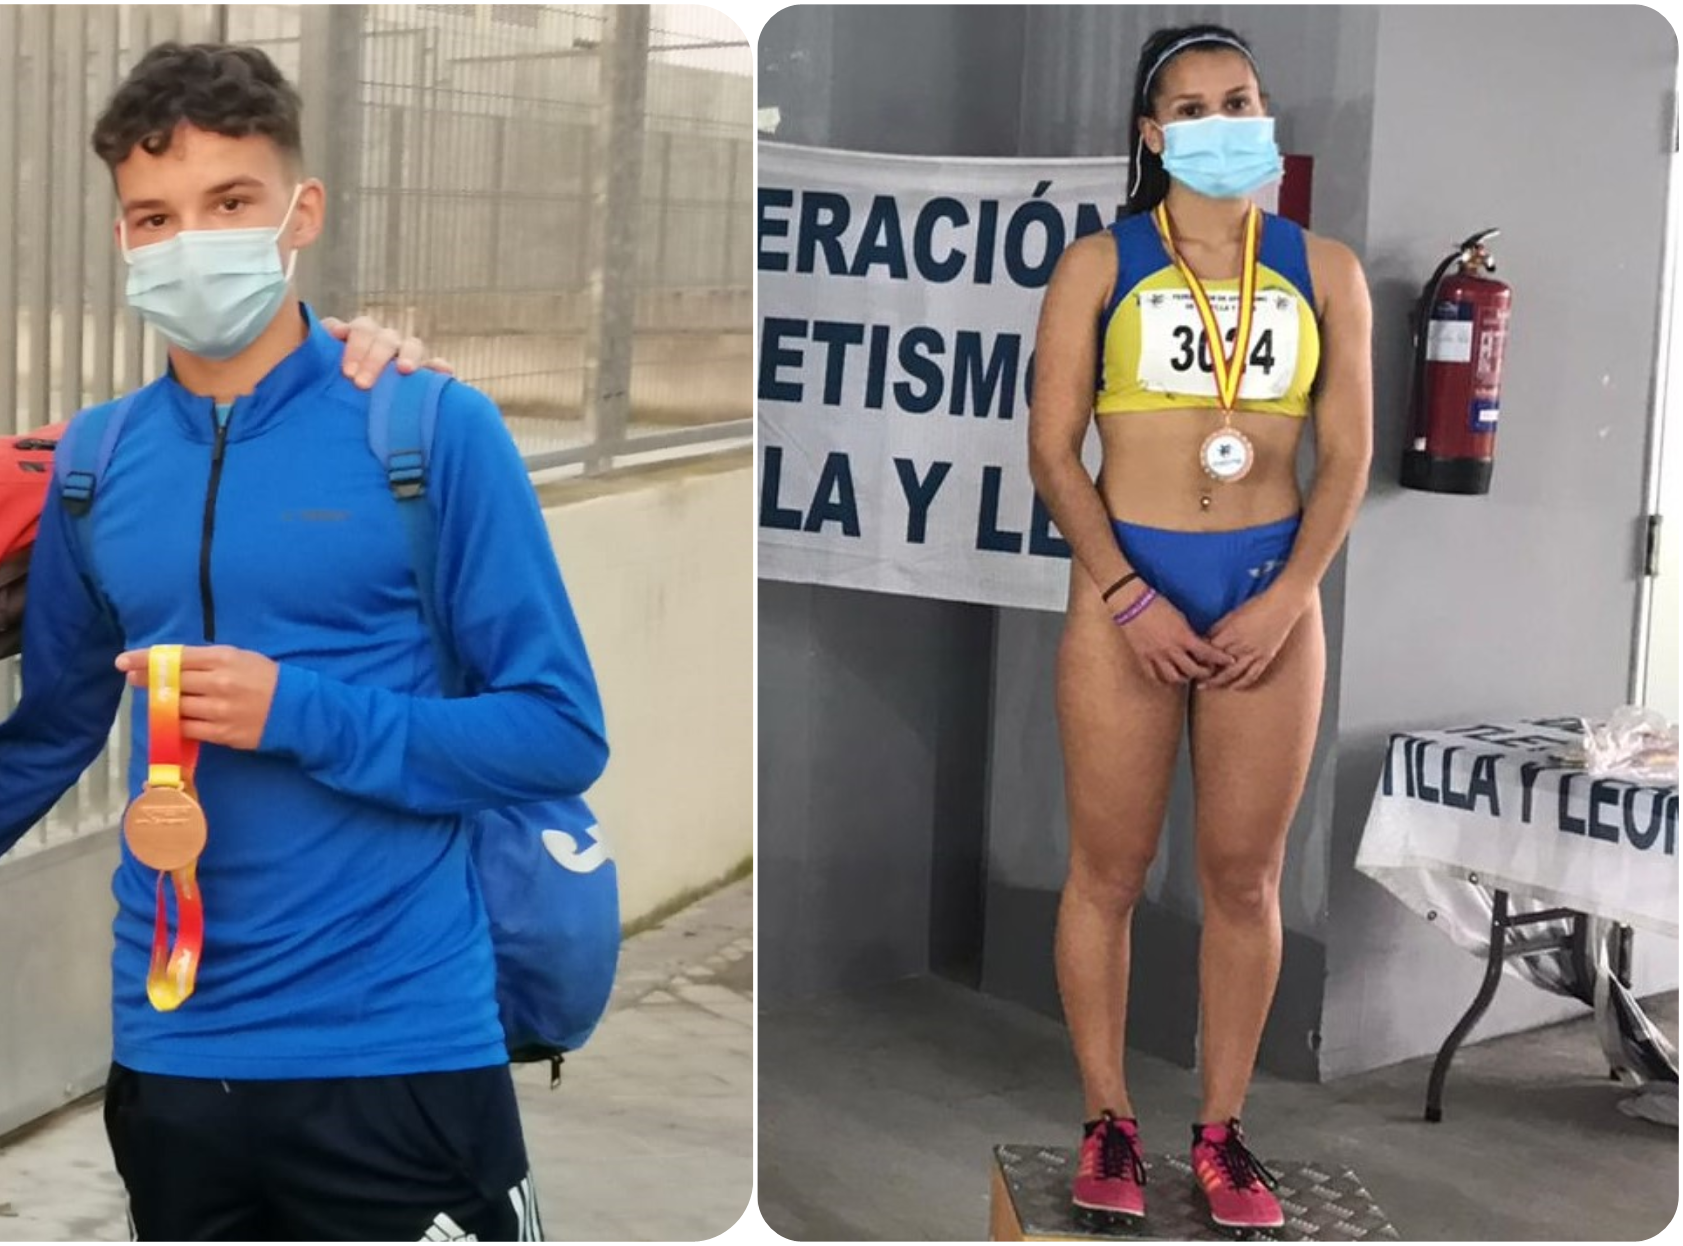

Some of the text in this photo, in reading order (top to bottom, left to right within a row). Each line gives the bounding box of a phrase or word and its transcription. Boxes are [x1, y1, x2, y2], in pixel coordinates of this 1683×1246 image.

[758, 316, 1035, 420] ETISM
[759, 446, 861, 538] LA
[893, 457, 953, 544] Y
